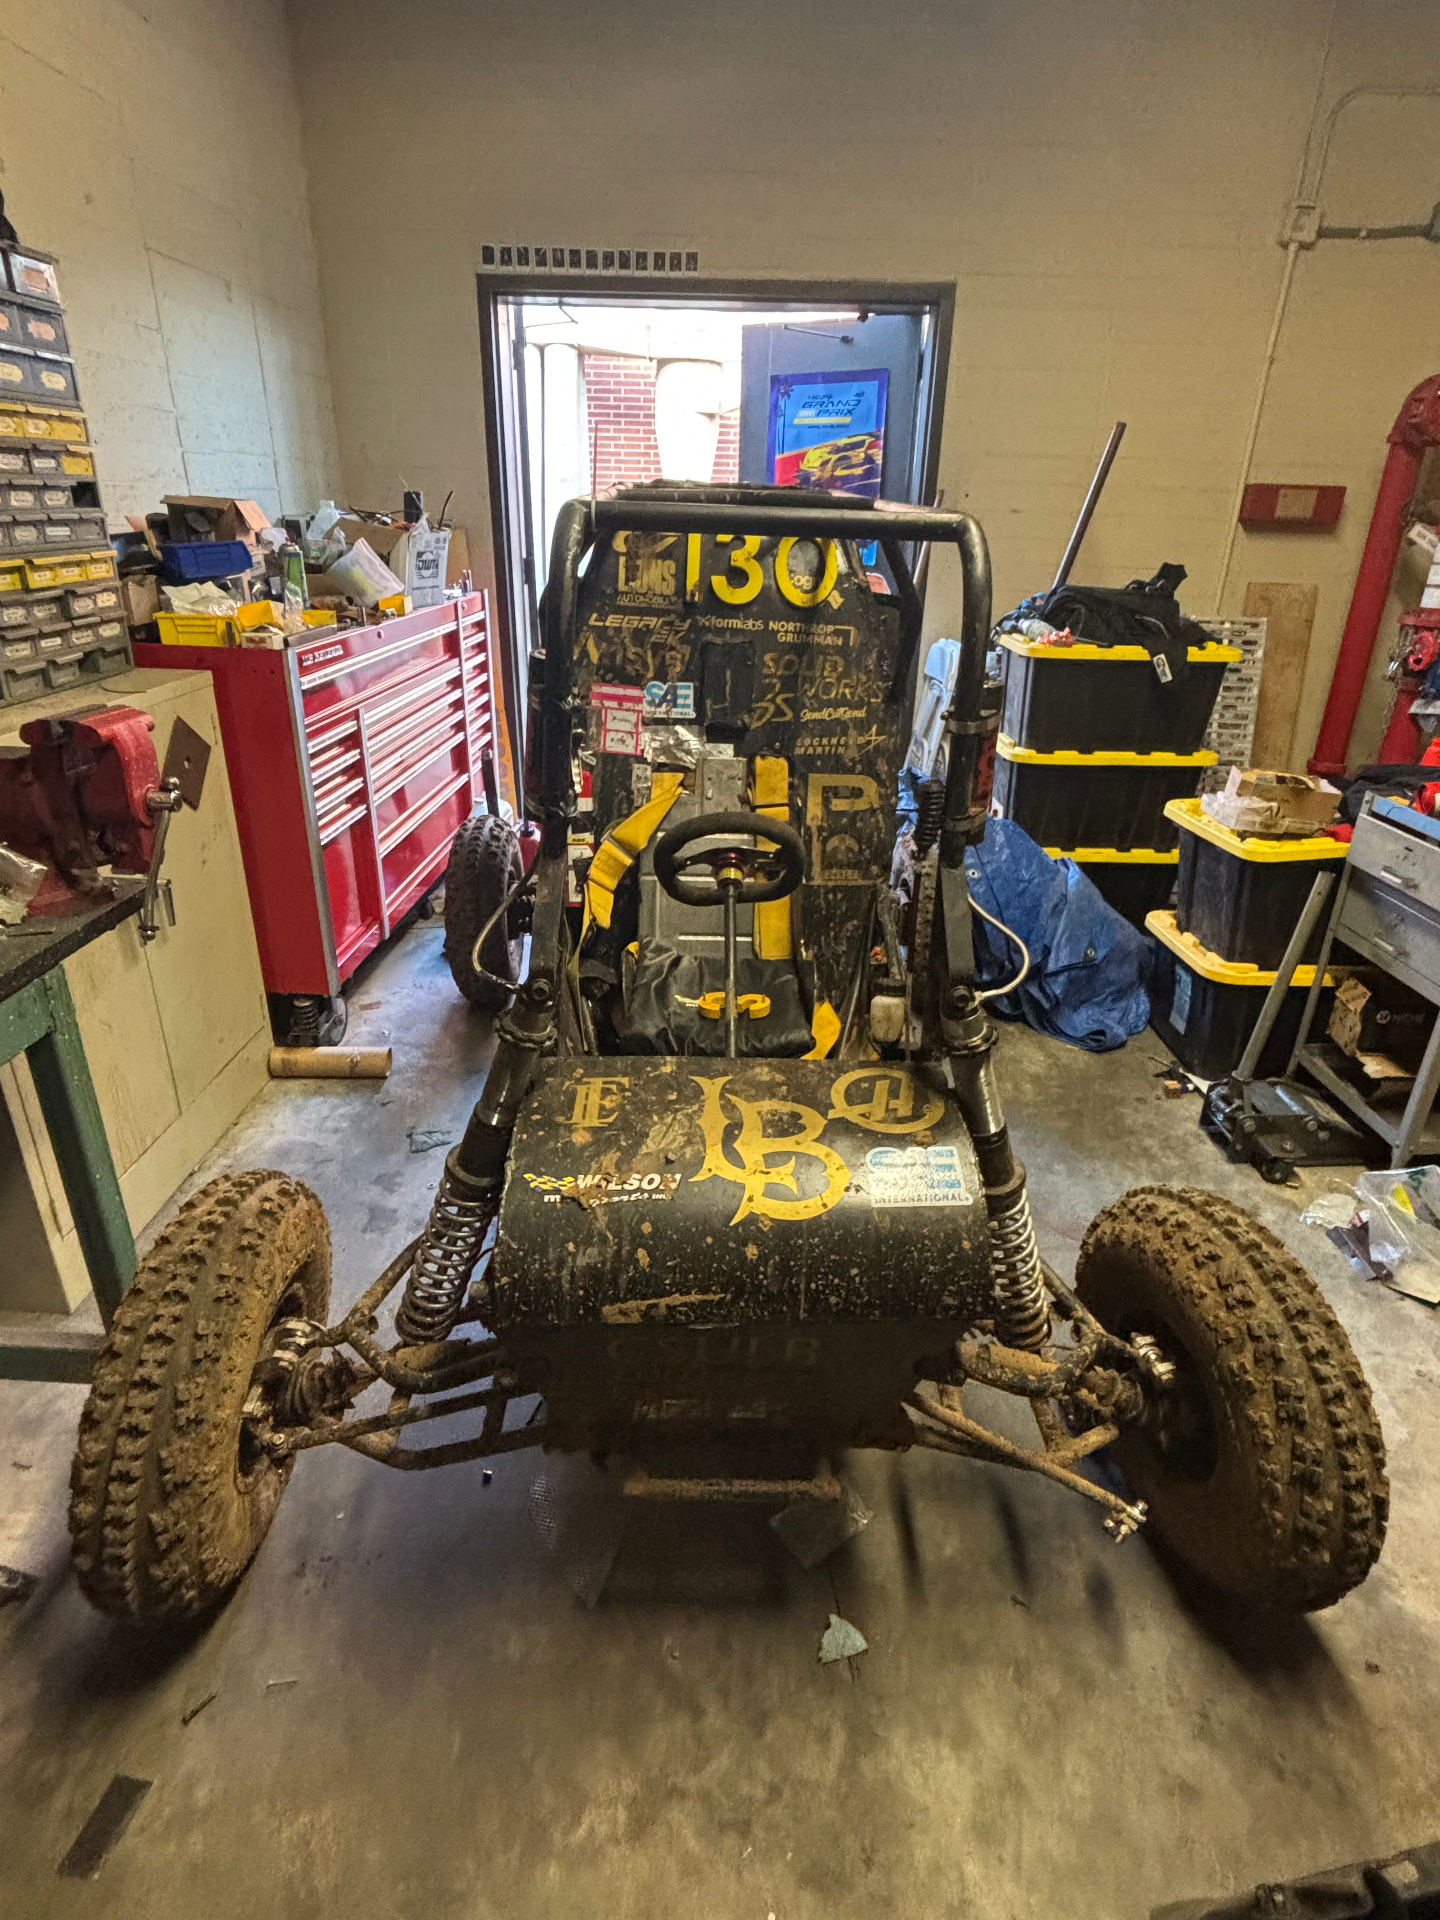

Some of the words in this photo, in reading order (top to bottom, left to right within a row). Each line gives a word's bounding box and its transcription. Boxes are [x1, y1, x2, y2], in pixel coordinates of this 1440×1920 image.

[802, 399, 861, 409] GRAND
[816, 408, 856, 417] PRIX
[644, 683, 692, 709] SAE
[794, 745, 846, 756] MARTIN
